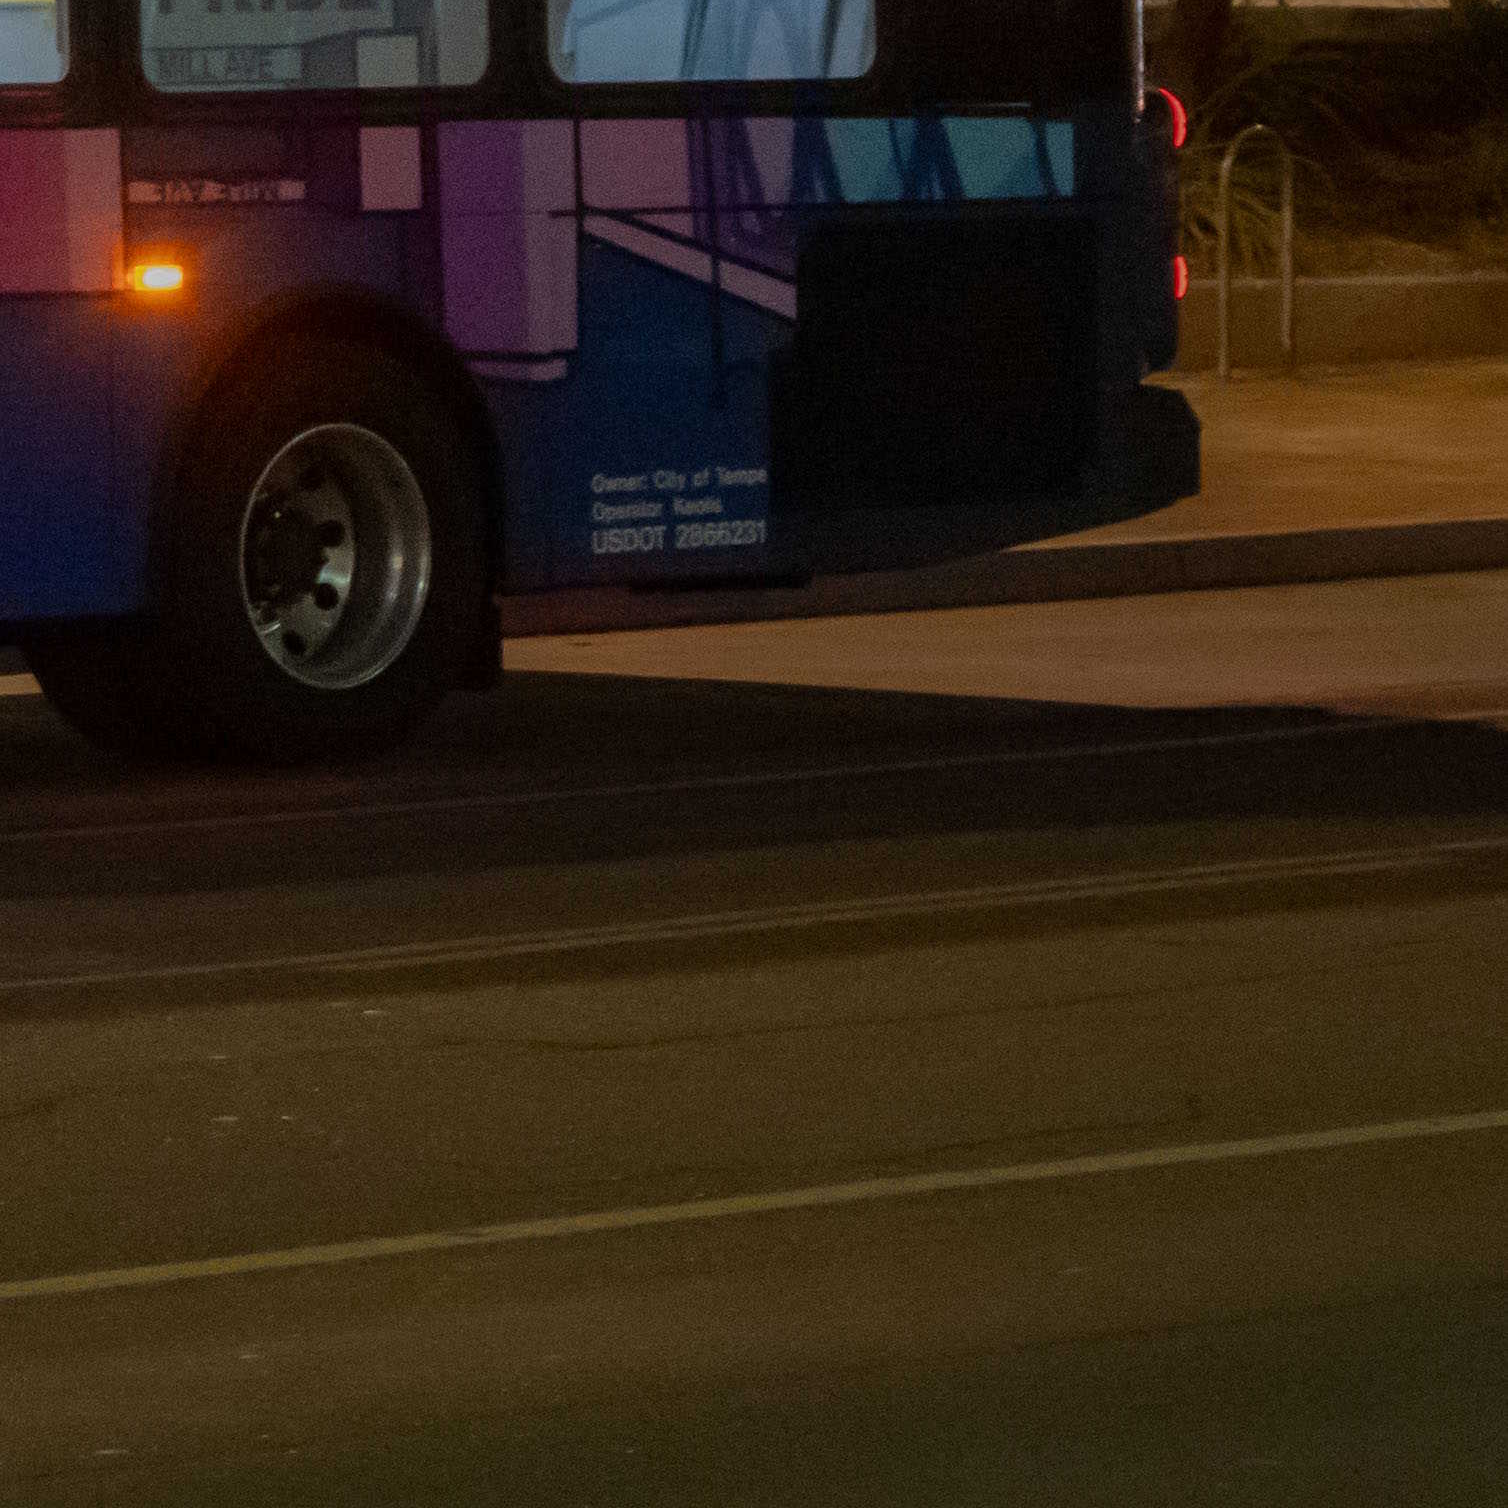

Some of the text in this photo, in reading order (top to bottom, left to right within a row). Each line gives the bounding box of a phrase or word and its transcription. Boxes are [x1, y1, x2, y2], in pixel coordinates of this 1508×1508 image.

[653, 469, 686, 491] City
[693, 467, 710, 487] of
[715, 466, 768, 486] Tempe
[592, 525, 666, 554] USDOT
